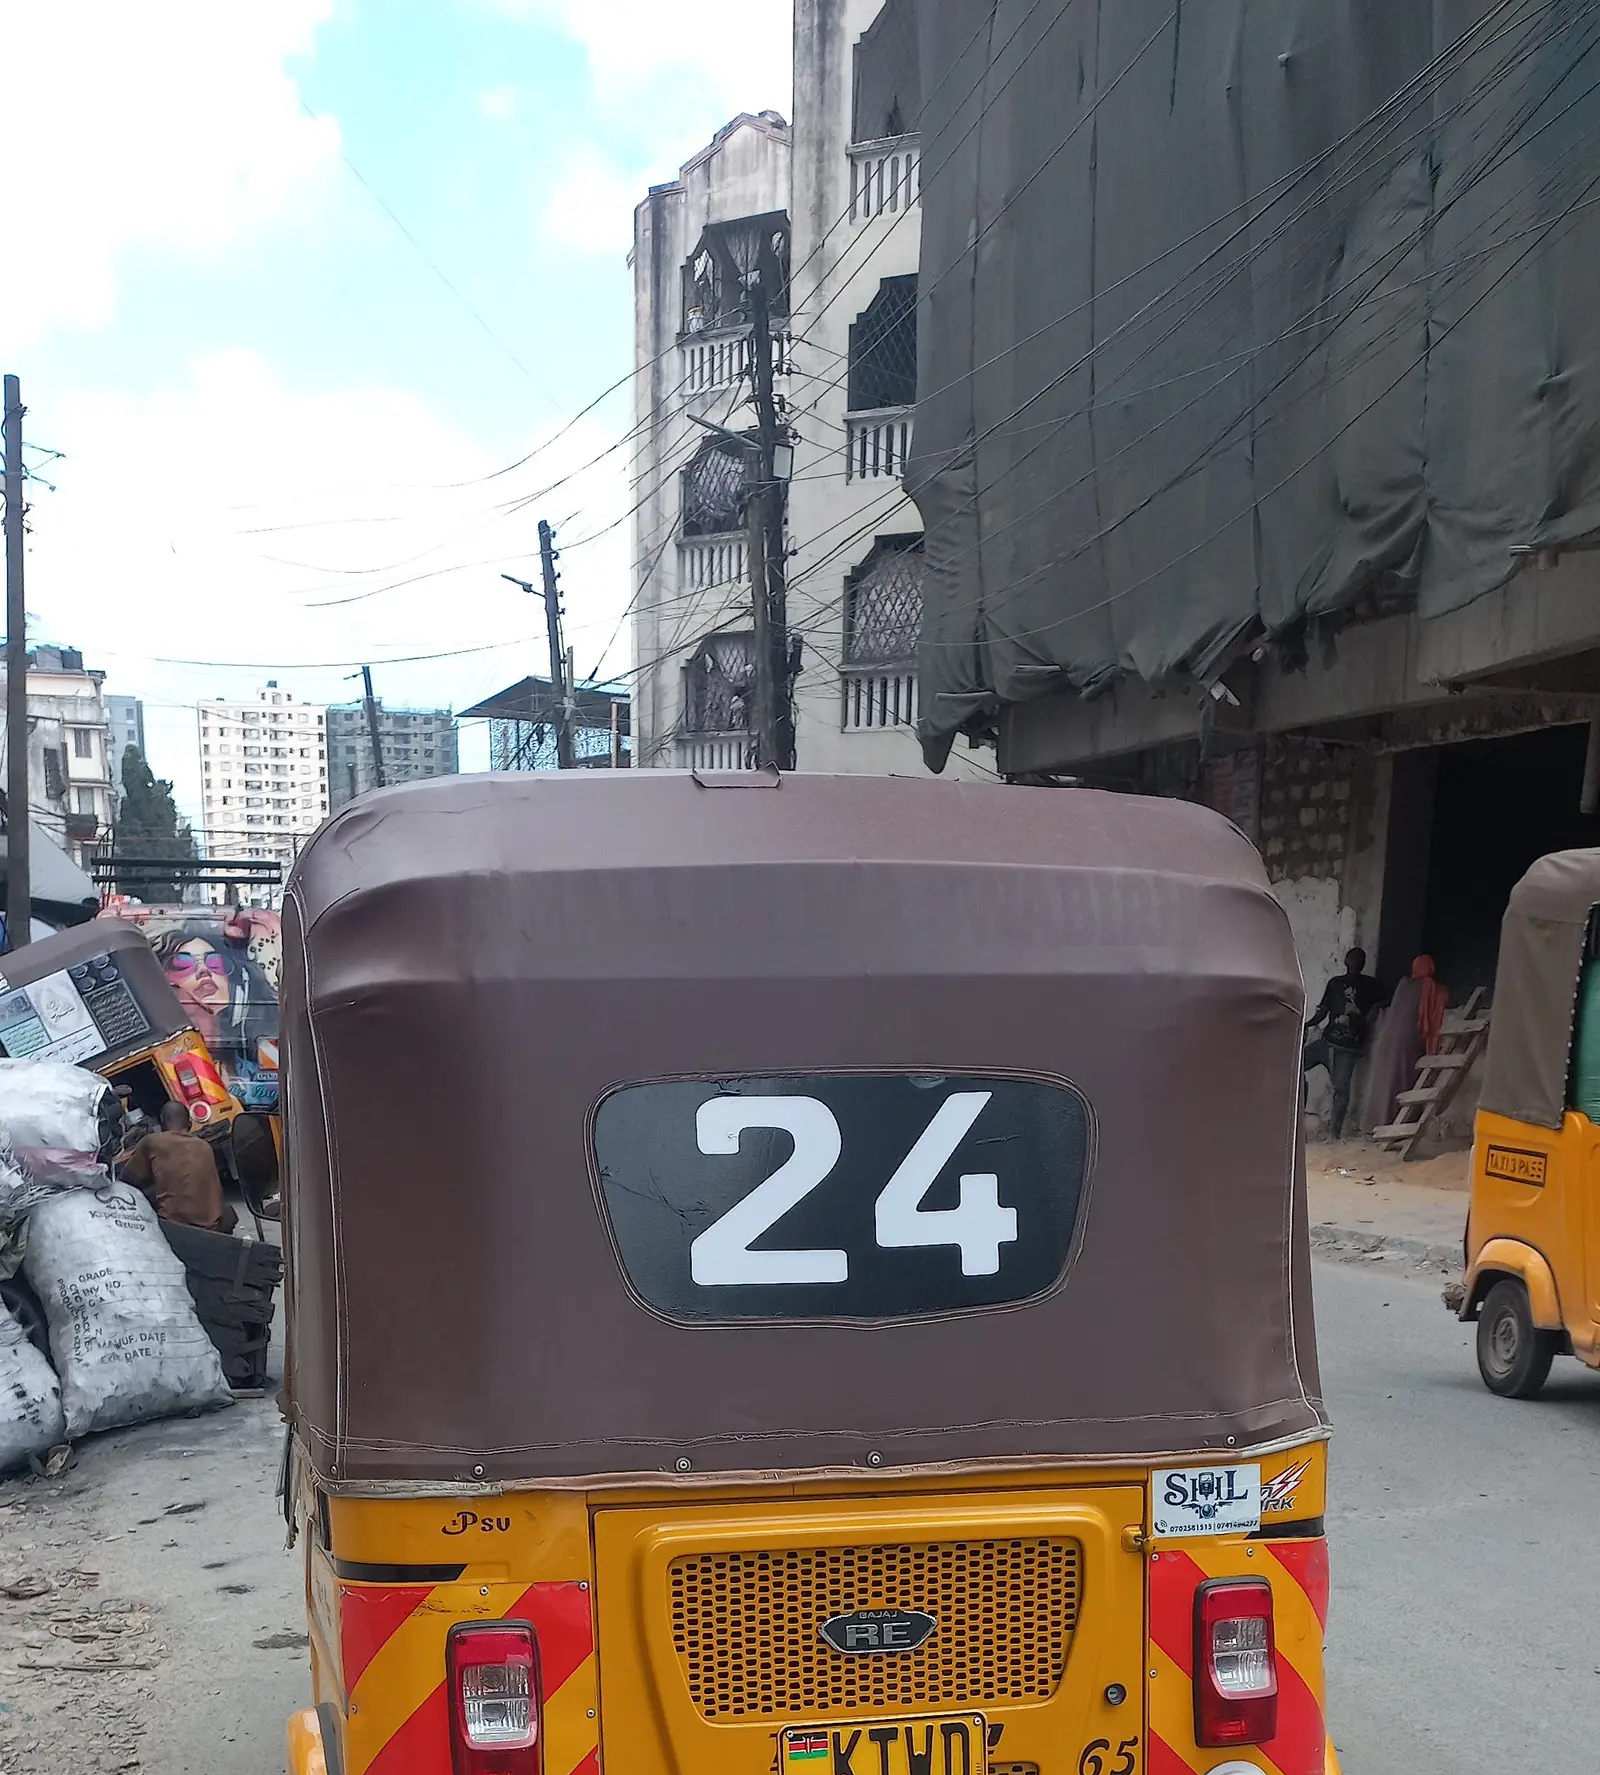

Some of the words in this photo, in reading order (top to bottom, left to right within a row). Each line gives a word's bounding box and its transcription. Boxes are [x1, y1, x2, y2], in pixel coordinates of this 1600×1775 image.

[691, 1091, 1018, 1286] 24
[139, 1332, 167, 1343] DATE
[124, 1347, 151, 1363] DATE
[859, 1610, 898, 1619] BAJAJ
[845, 1621, 911, 1647] RE
